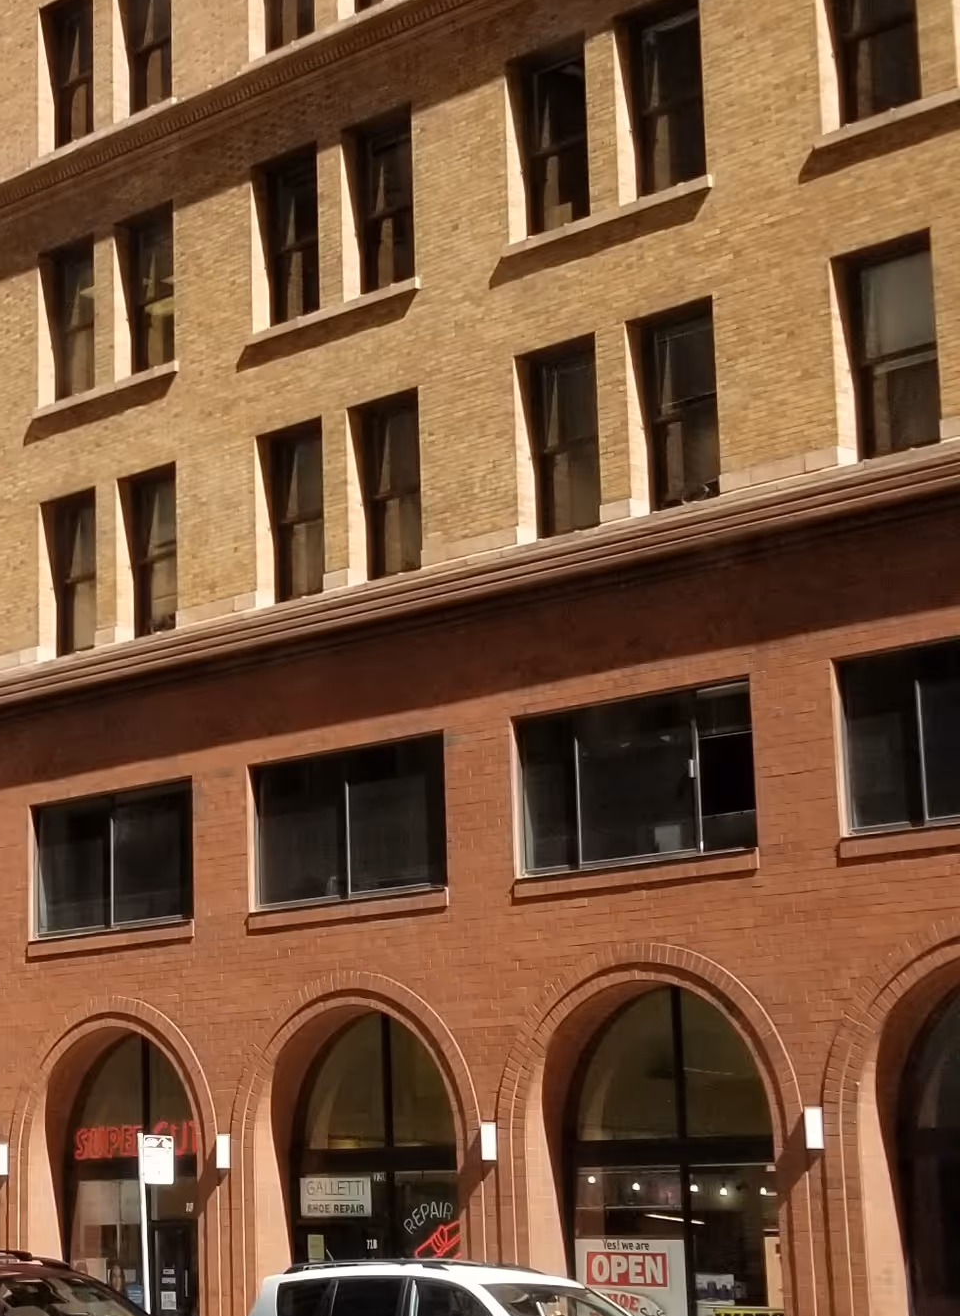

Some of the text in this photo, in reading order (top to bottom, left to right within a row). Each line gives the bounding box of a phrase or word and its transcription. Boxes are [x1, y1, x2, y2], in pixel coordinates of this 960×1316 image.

[306, 1180, 365, 1196] GALLETTI
[307, 1204, 365, 1214] SHOE REPAIR
[403, 1201, 453, 1235] REPAIR
[603, 1239, 650, 1251] Yes! we are
[591, 1255, 664, 1284] OPEN
